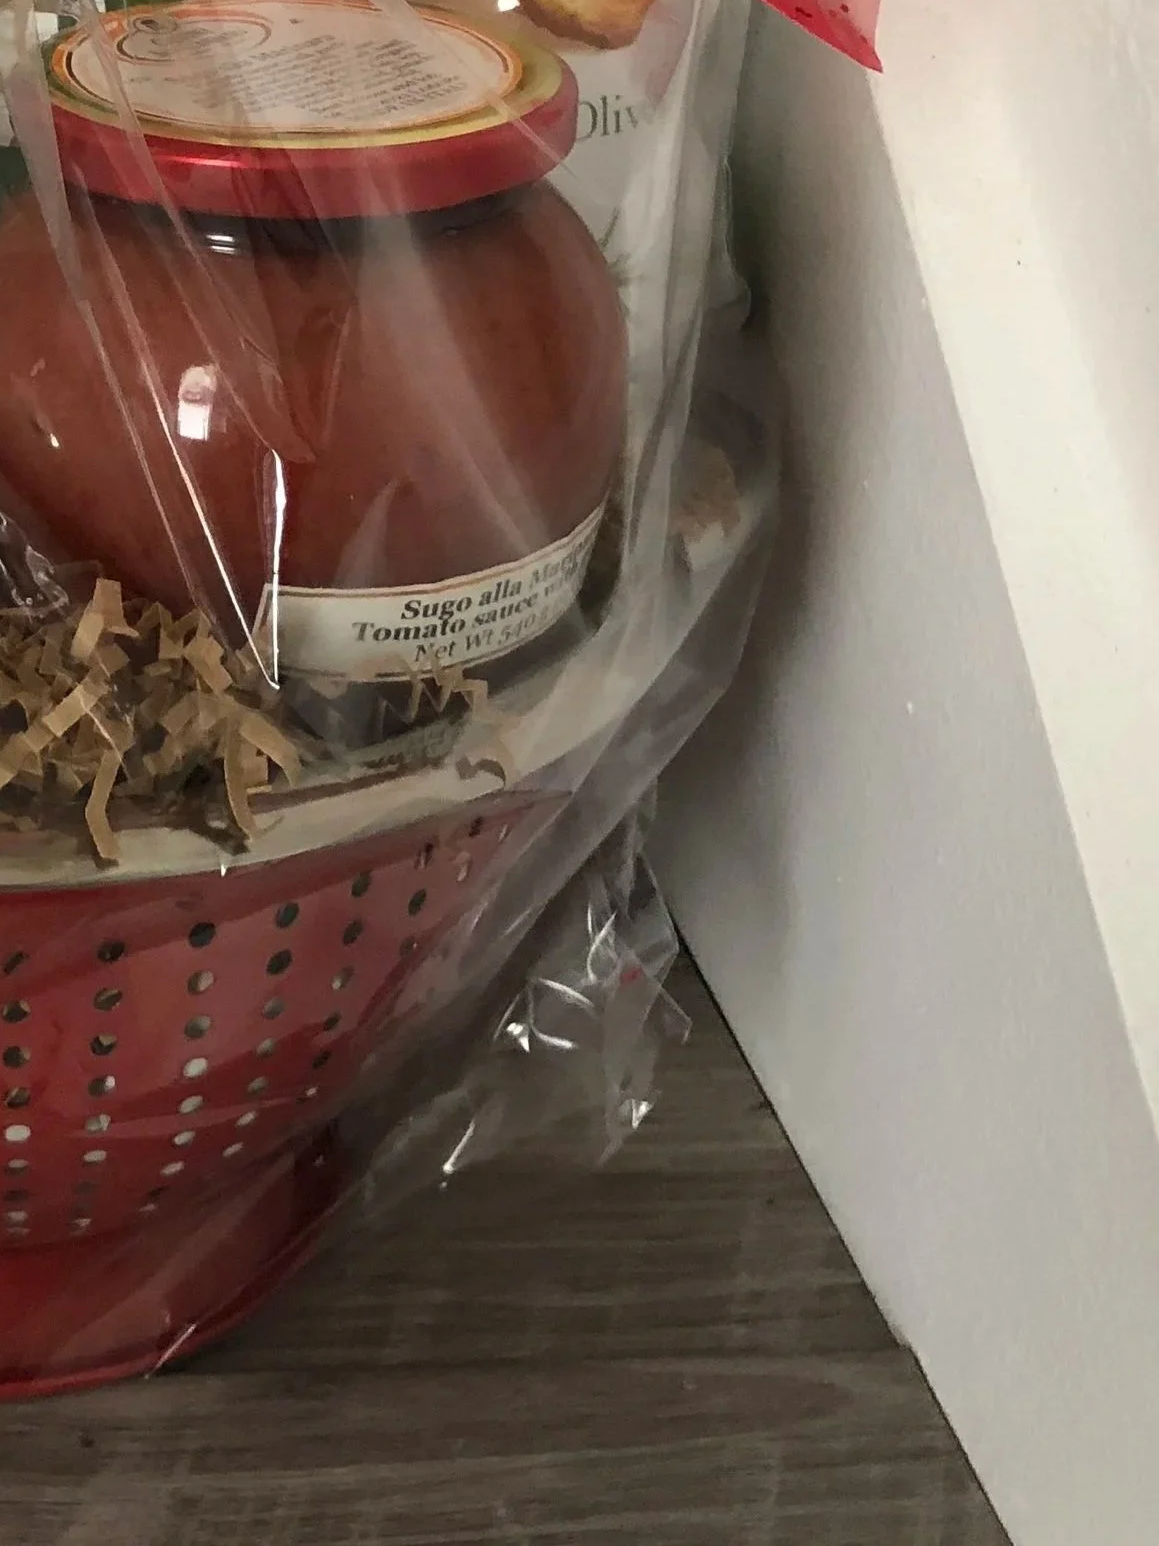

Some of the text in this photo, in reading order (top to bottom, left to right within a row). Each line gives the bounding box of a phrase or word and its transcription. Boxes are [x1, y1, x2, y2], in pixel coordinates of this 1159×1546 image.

[578, 94, 646, 141] Oliv
[352, 615, 467, 642] Tomato
[472, 590, 538, 628] sauce
[401, 577, 522, 621] Sugo alla
[415, 640, 457, 663] Net
